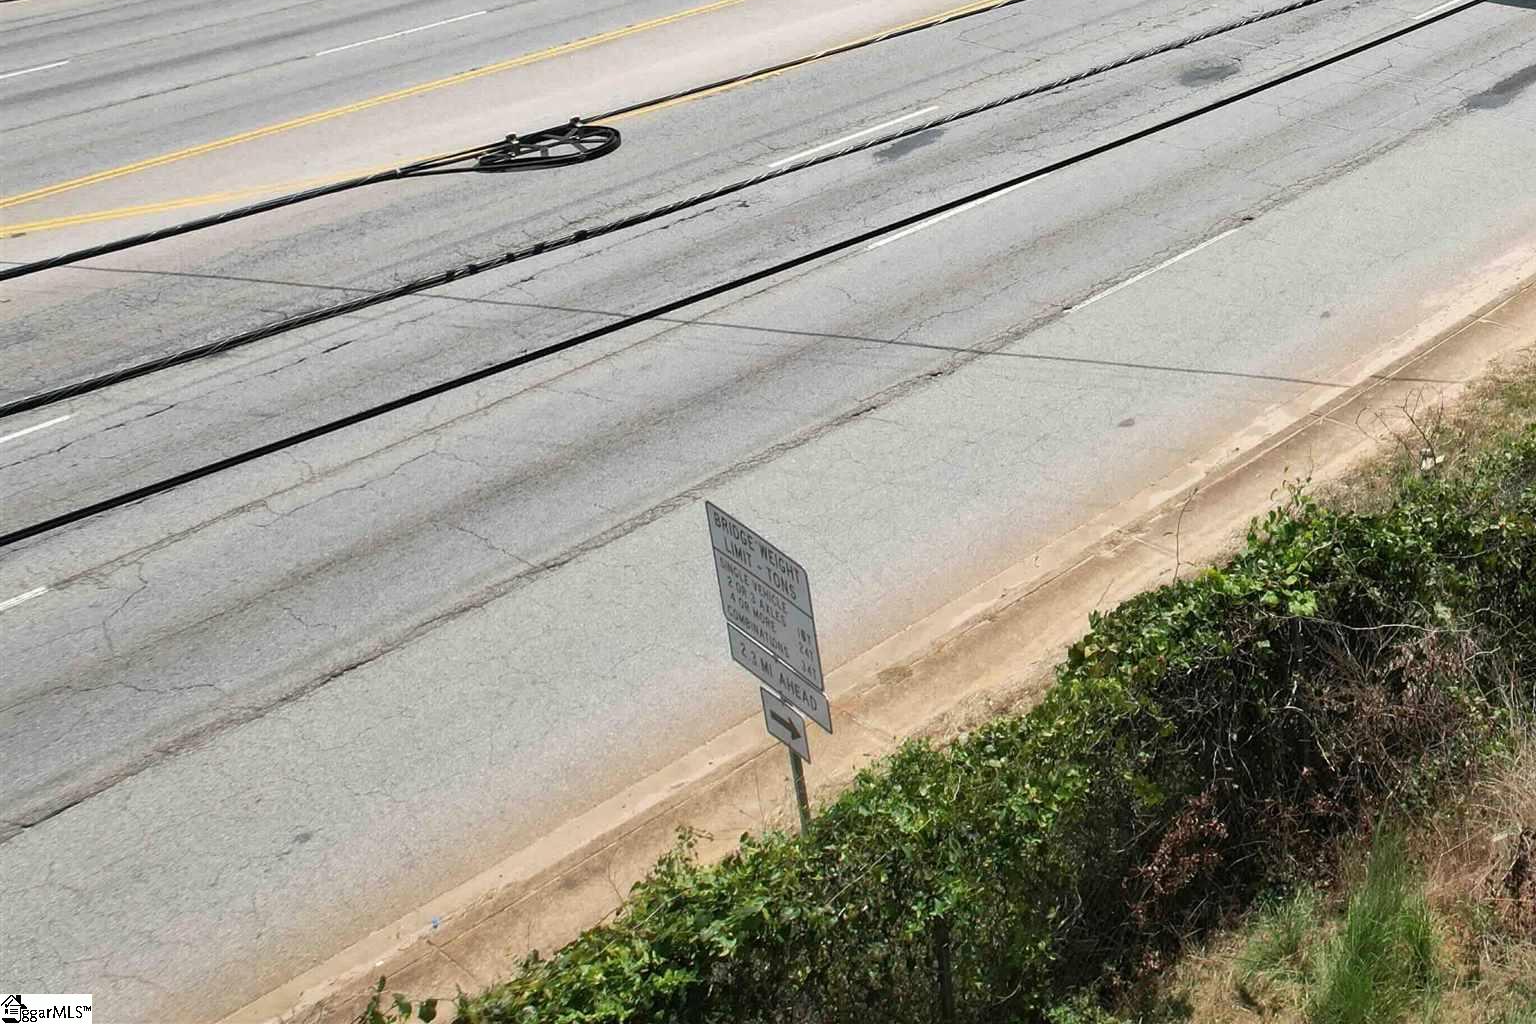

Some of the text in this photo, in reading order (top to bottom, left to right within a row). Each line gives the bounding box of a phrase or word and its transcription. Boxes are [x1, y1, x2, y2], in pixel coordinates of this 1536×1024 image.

[714, 511, 800, 584] BRIDGE WEIGHT
[724, 537, 752, 568] LIMIT
[767, 569, 796, 600] TONS
[779, 672, 817, 711] AHEAD
